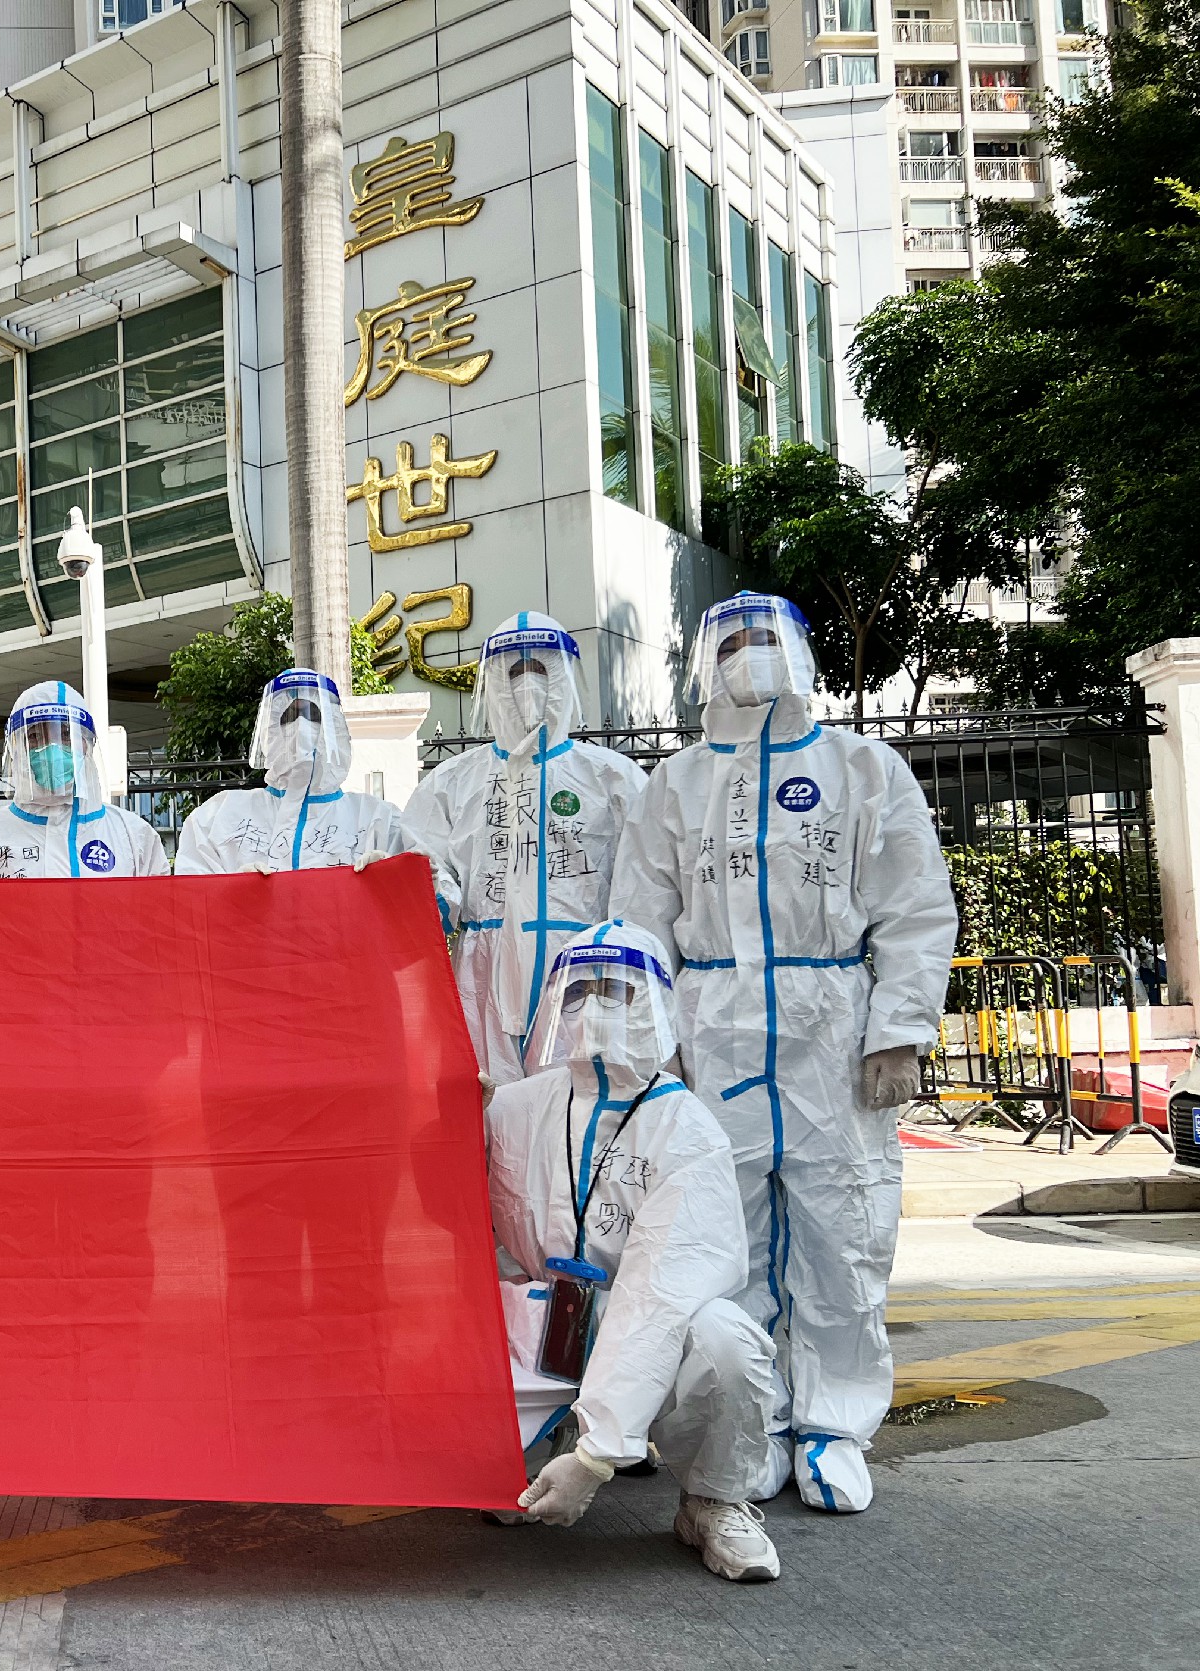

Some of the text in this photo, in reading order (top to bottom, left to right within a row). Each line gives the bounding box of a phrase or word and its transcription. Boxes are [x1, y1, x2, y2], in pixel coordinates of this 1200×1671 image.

[344, 131, 499, 692] 皇庭世纪
[494, 633, 545, 646] Face Shield
[785, 783, 813, 798] ZD
[87, 845, 110, 860] ZD
[547, 847, 599, 881] 建工
